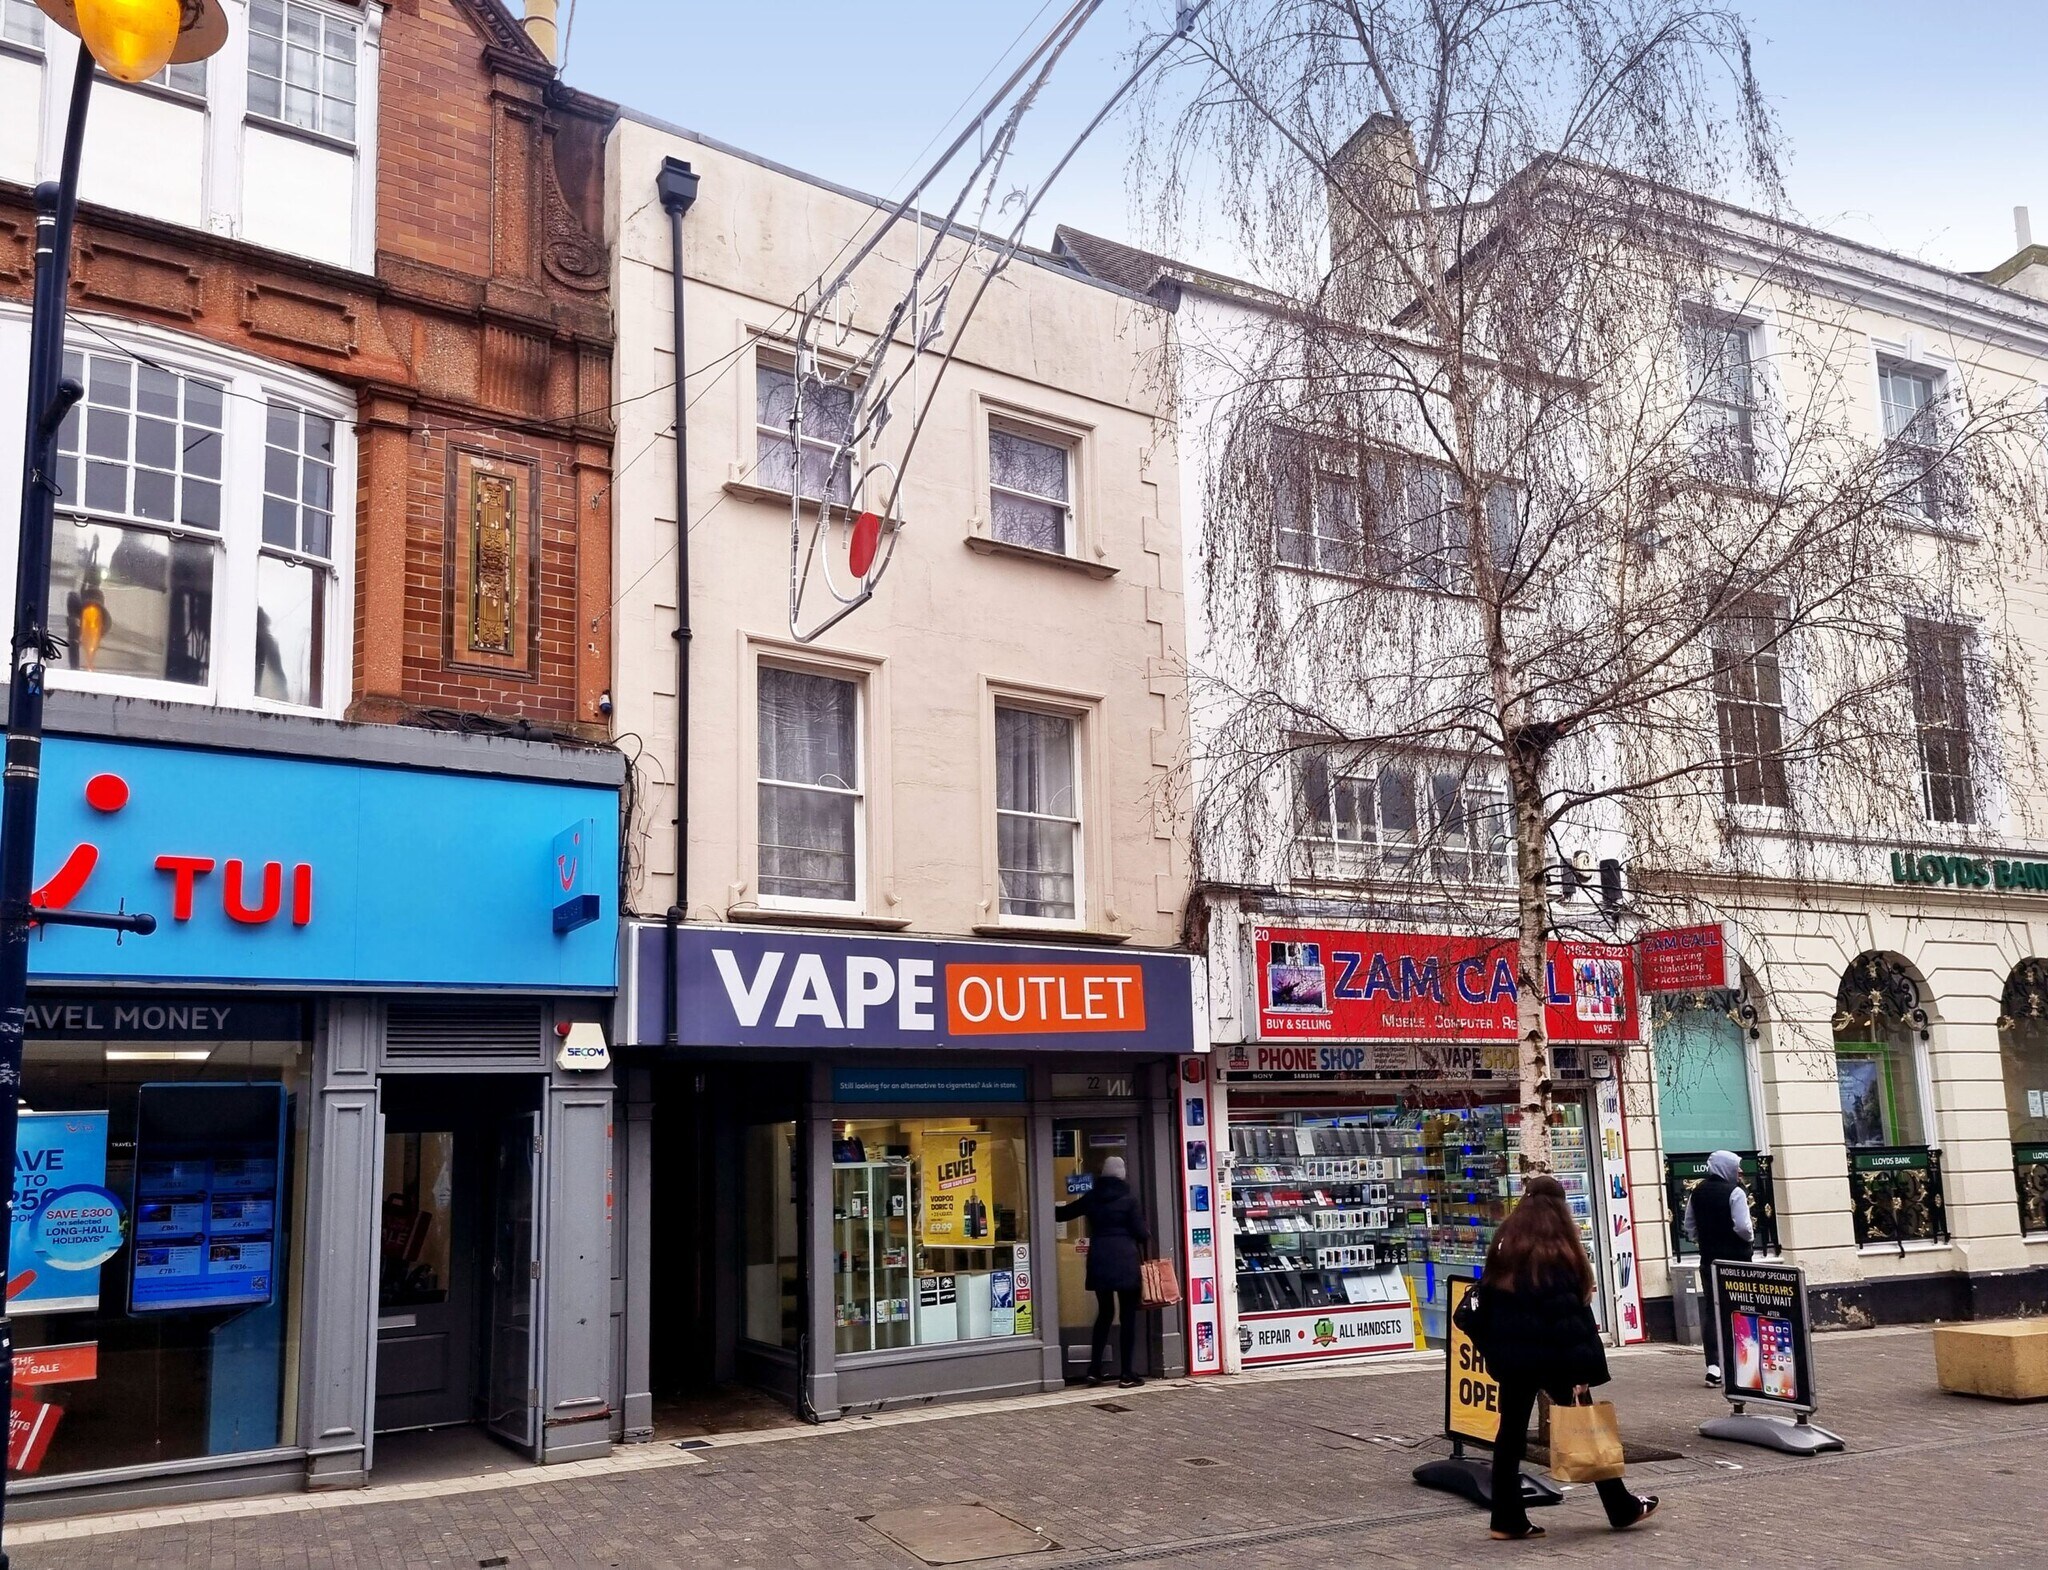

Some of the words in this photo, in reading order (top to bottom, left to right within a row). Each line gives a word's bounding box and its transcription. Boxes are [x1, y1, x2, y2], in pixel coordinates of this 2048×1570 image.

[1890, 851, 1990, 886] LLOYDS
[155, 855, 312, 926] TUI
[1254, 929, 1269, 941] 20
[1645, 936, 1678, 953] ZAM
[1681, 931, 1718, 947] CALL
[1659, 952, 1702, 964] Repairing
[1660, 963, 1705, 974] Unlocking
[1332, 951, 1443, 1004] ZAM
[1456, 957, 1572, 1005] CAL
[711, 949, 934, 1031] VAPE
[958, 976, 1132, 1023] OUTLET
[24, 1005, 103, 1029] AVEL
[114, 1006, 231, 1030] MONEY
[1266, 1019, 1284, 1029] BUY
[1286, 1019, 1294, 1029] &
[1296, 1019, 1332, 1030] SELLING
[1502, 1016, 1518, 1030] RE
[1593, 1024, 1613, 1034] VAPE
[567, 1047, 605, 1057] SECOM
[1258, 1048, 1317, 1070] PHONE
[1320, 1048, 1365, 1070] SHOP
[1441, 1047, 1481, 1069] VAPE
[855, 1082, 879, 1091] looking
[946, 1082, 980, 1091] cigarettes?
[1087, 1076, 1100, 1090] 22
[959, 1137, 977, 1158] UP
[937, 1158, 977, 1182] LEVEL
[1693, 1164, 1710, 1173] LLOY
[22, 1174, 48, 1187] TO
[1068, 1182, 1092, 1192] OPEN
[46, 1209, 78, 1220] SAVE
[81, 1208, 113, 1218] £300
[68, 1218, 102, 1226] selected
[46, 1225, 112, 1237] LONG-HAUL
[1720, 1268, 1740, 1277] MOBILE
[1741, 1269, 1746, 1277] &
[1746, 1270, 1766, 1280] LAPTOP
[1767, 1272, 1797, 1282] SPECIALIST
[1725, 1281, 1757, 1293] MOBILE
[1760, 1284, 1794, 1296] REPAIRS
[1729, 1291, 1754, 1304] WHILE
[1756, 1294, 1771, 1305] YOU
[1772, 1296, 1792, 1307] WAIT
[1740, 1304, 1756, 1312] BEFORE
[1258, 1329, 1291, 1346] REPAIR
[1321, 1322, 1326, 1332] 1
[1339, 1323, 1356, 1339] ALL
[1357, 1319, 1402, 1337] HANDSETS
[1459, 1343, 1487, 1374] SH
[31, 1363, 60, 1374] SALE
[1459, 1378, 1500, 1413] OPE
